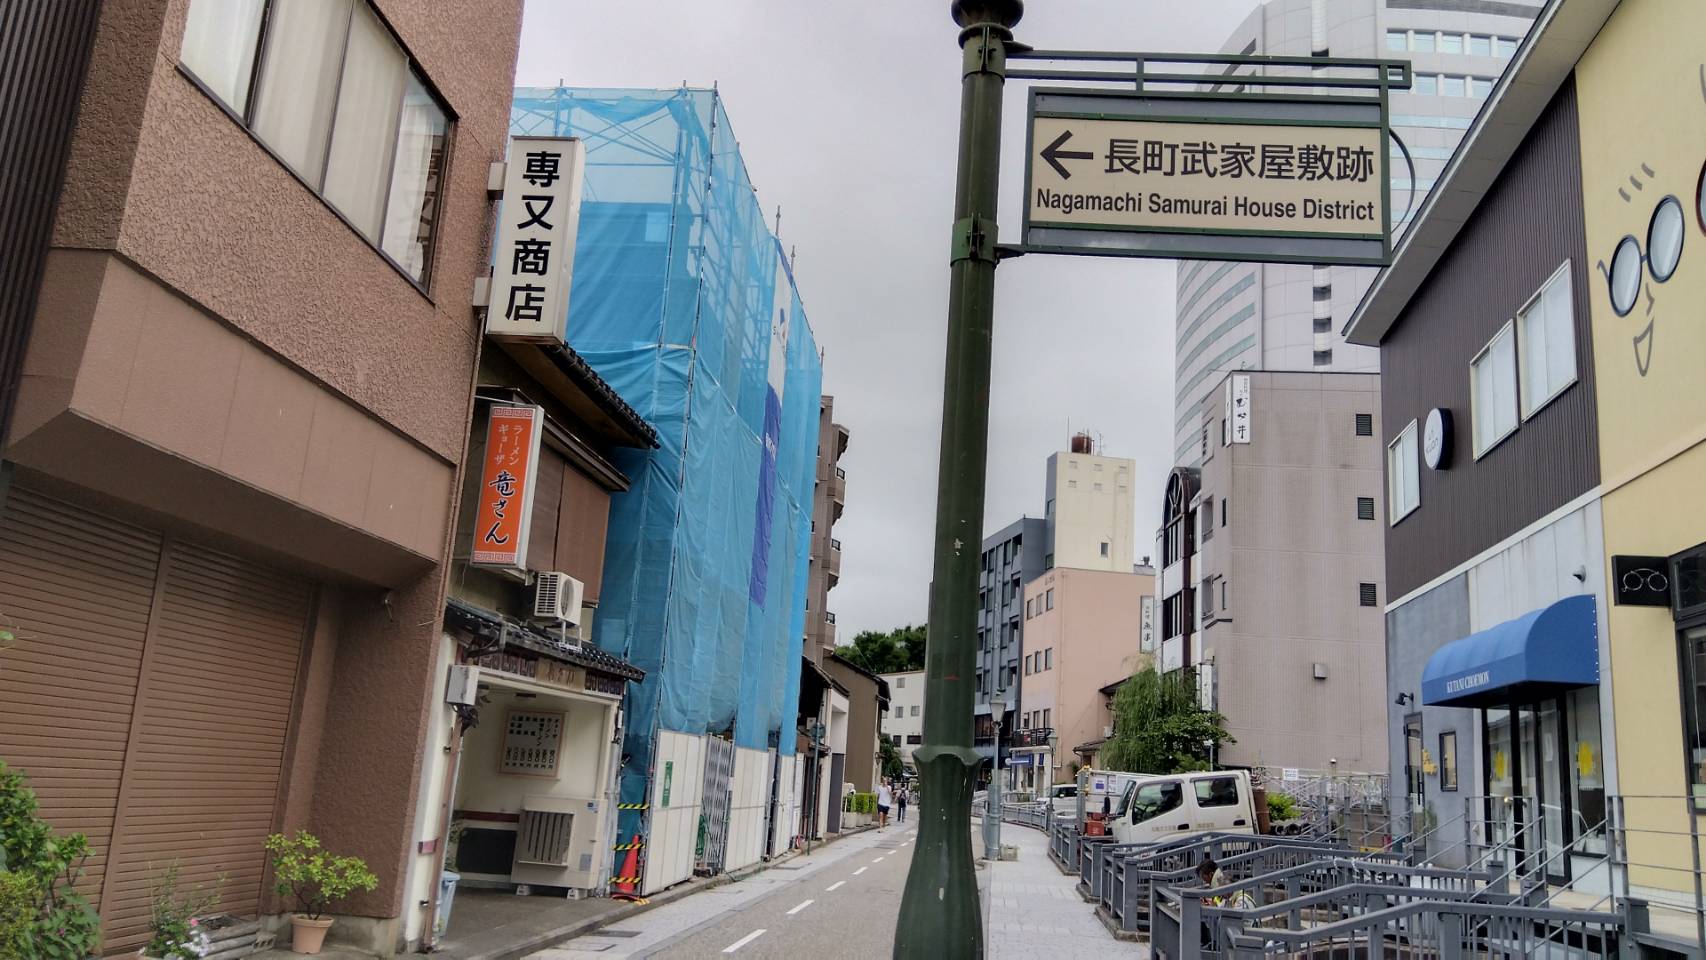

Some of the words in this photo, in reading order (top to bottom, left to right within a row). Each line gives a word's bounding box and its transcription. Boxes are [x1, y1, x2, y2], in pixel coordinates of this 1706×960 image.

[1104, 138, 1375, 183] 長町武家屋敷跡
[1036, 188, 1143, 215] Nagamachi
[1148, 192, 1229, 217] Samurai
[1234, 196, 1297, 219] House
[1303, 198, 1375, 221] District
[504, 151, 562, 322] 専又商店
[494, 424, 510, 468] ギョーザ
[508, 424, 523, 466] ラーメン
[484, 471, 517, 545] 竜さん
